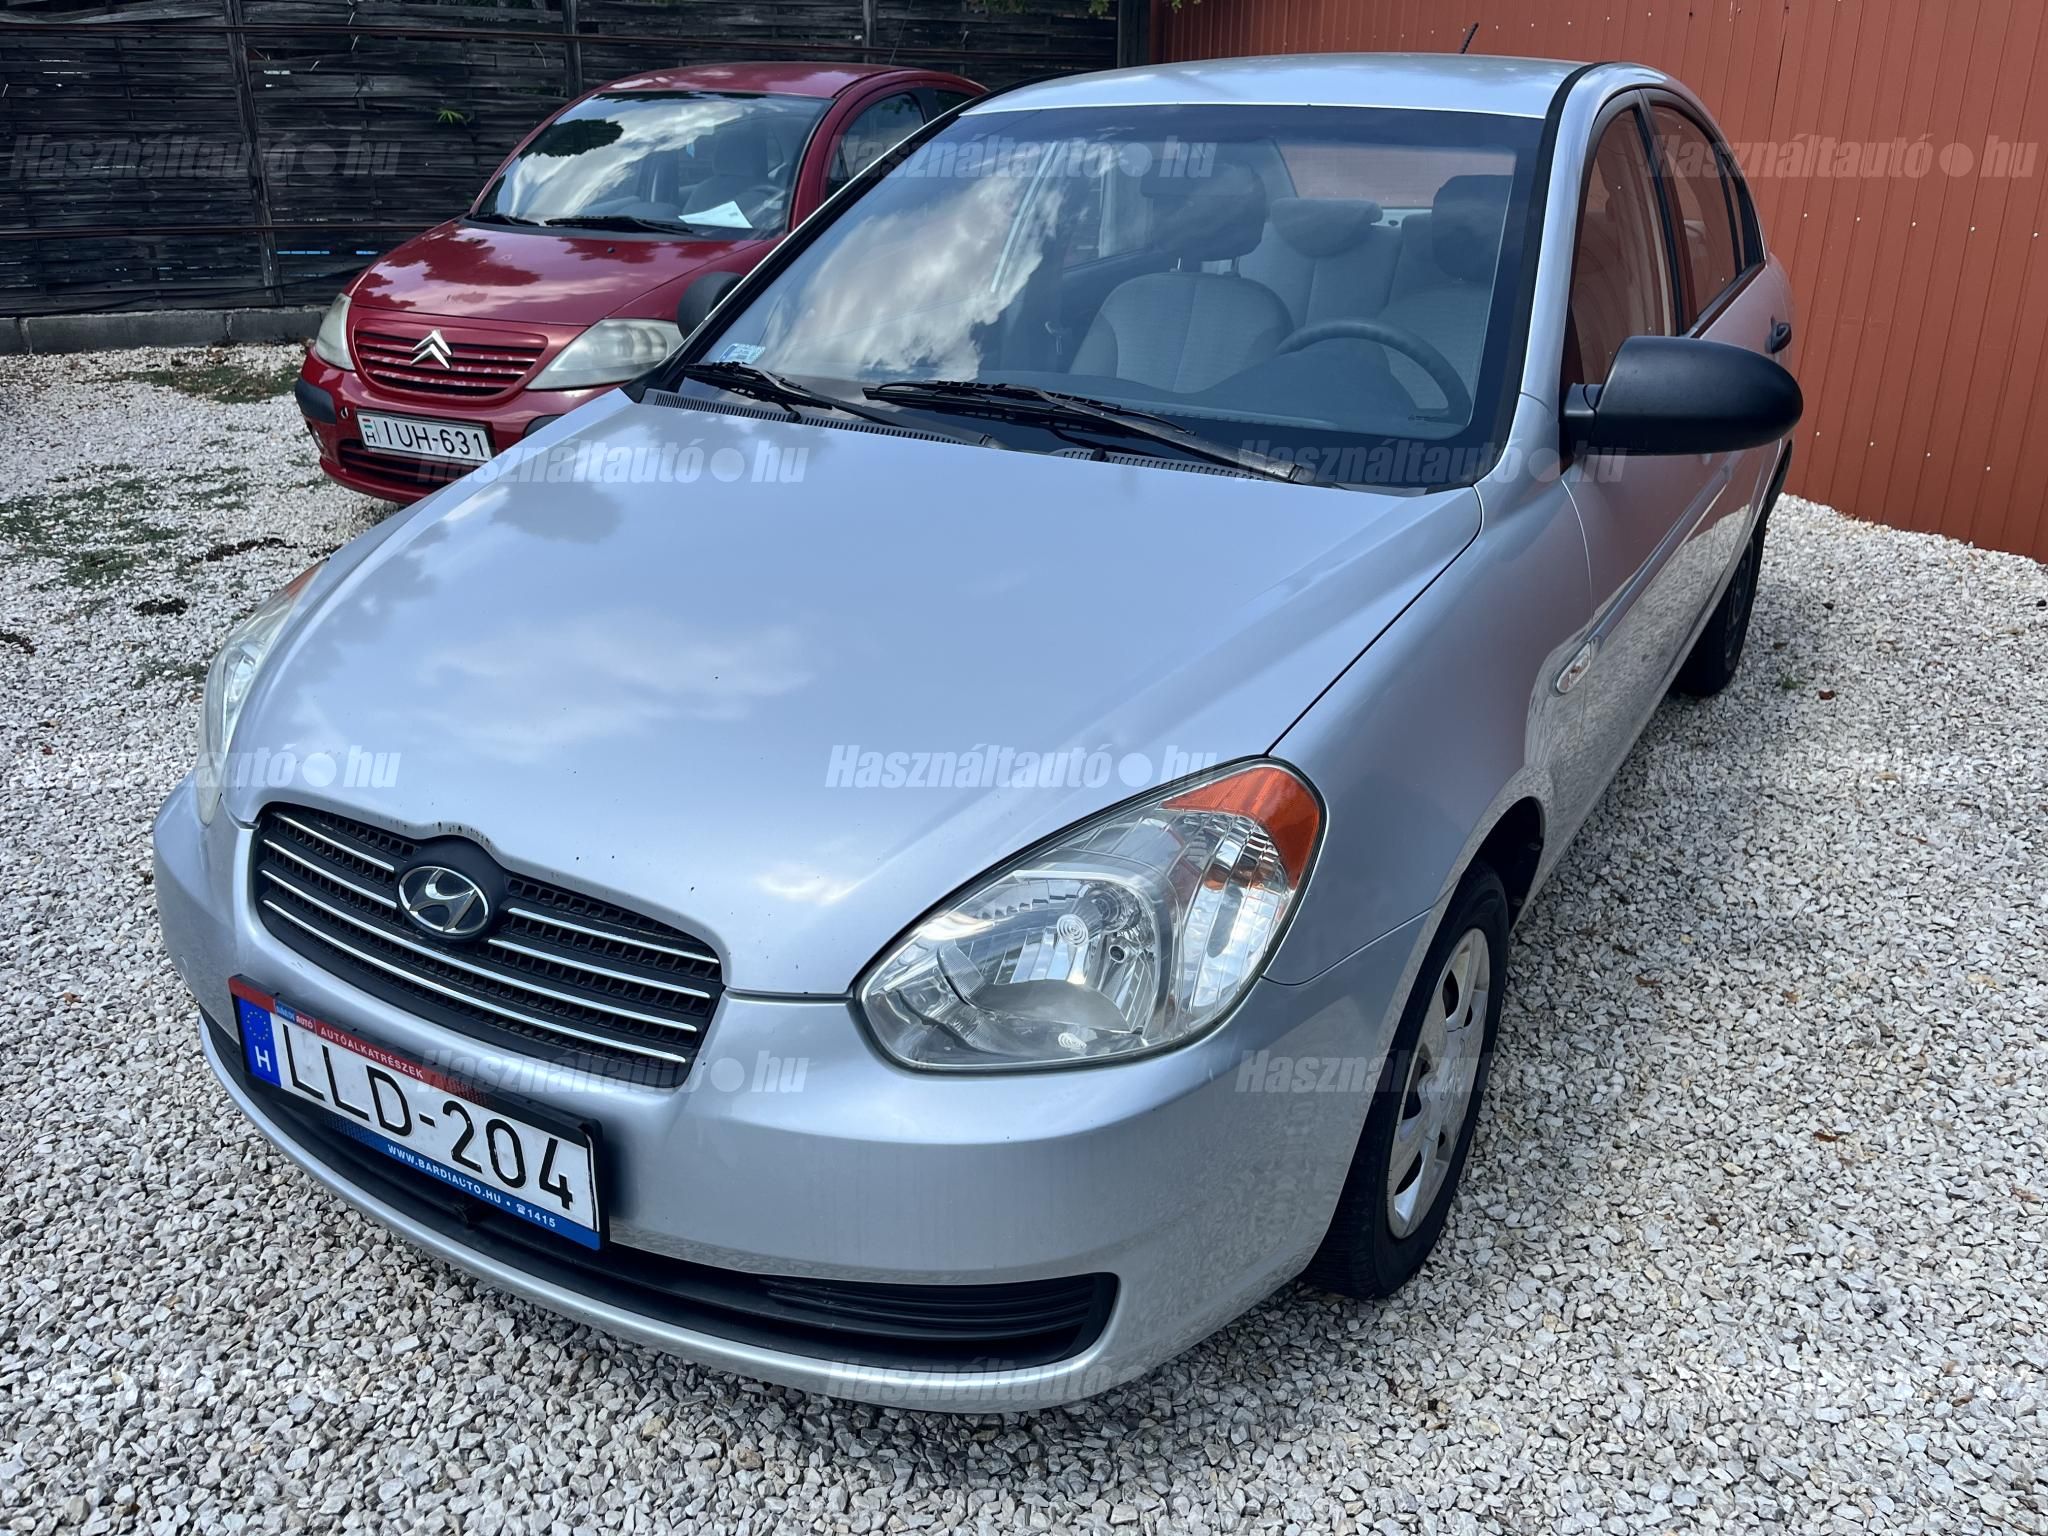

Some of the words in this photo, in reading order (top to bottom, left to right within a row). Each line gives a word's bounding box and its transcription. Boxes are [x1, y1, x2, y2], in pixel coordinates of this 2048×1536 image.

[384, 420, 485, 457] IUH-631
[255, 1045, 272, 1073] H
[320, 1027, 423, 1079] AUTÓALKATRÉSZEK
[282, 1023, 574, 1210] LLD-204
[387, 1143, 501, 1205] WWW.BARDIAUTO.HU
